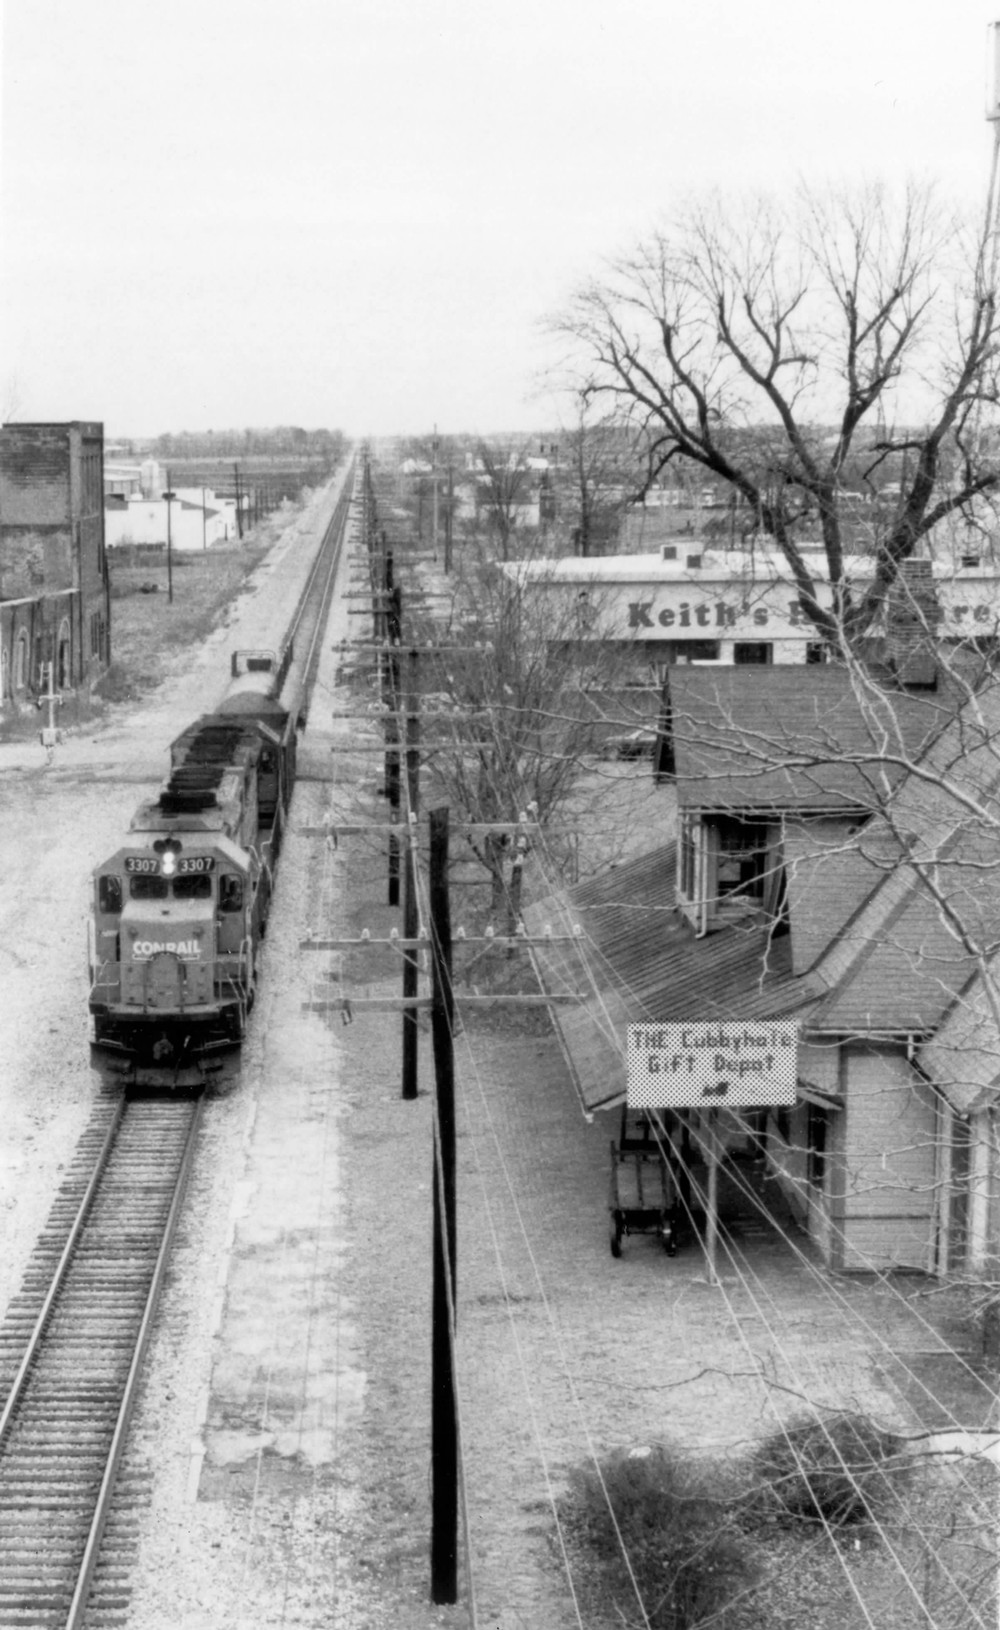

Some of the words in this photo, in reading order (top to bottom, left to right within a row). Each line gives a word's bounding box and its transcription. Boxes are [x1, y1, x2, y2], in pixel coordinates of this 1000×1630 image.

[628, 602, 769, 628] Keith's
[128, 858, 158, 873] 3307
[180, 857, 213, 872] 3307
[133, 940, 202, 954] CONRAIL
[632, 1029, 668, 1049] THE
[681, 1028, 791, 1053] Cubbyhole
[714, 1054, 774, 1078] Depot
